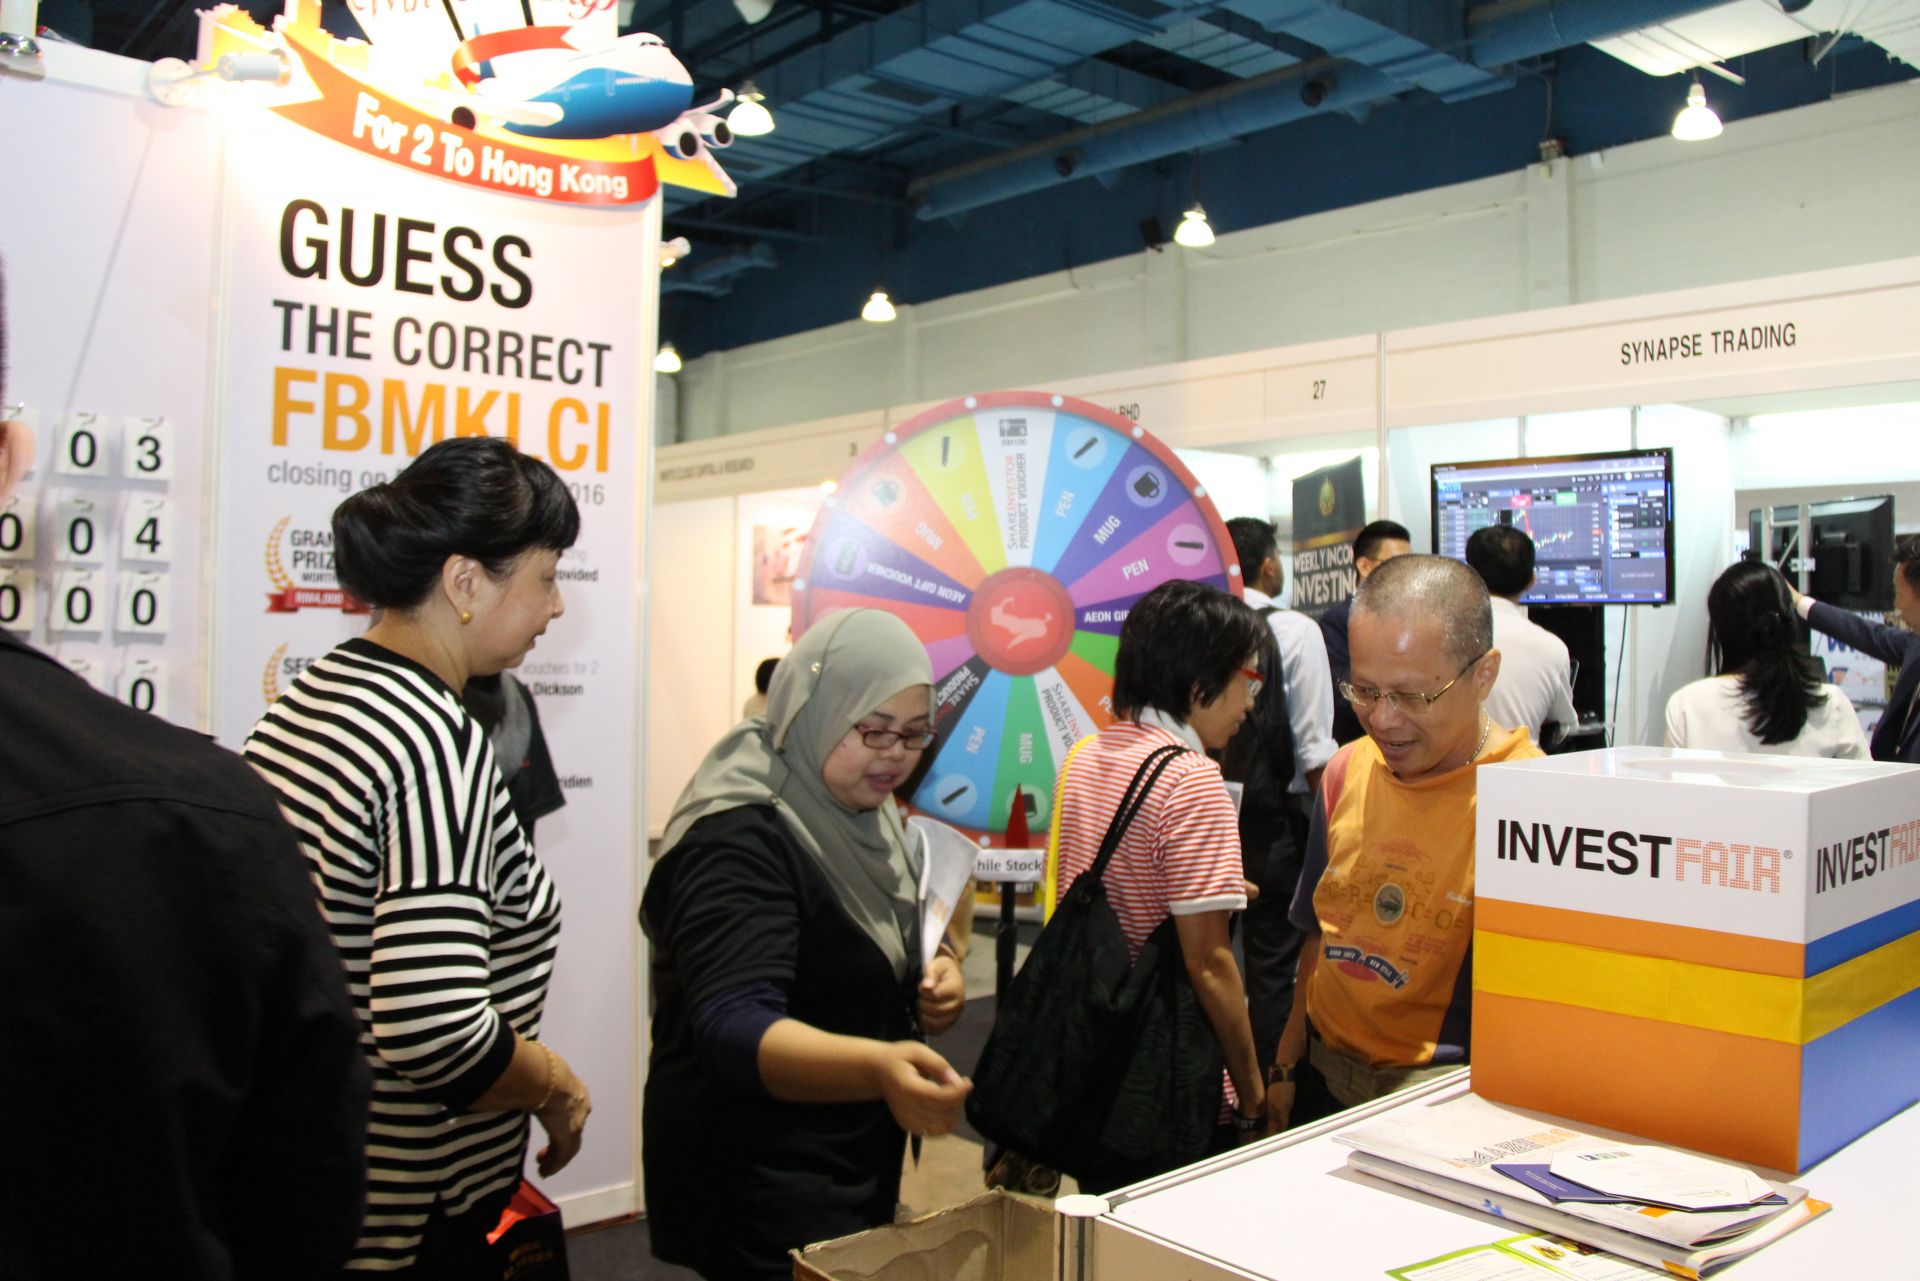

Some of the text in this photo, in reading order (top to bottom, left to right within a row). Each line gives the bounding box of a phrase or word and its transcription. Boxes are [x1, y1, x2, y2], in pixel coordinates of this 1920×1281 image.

[353, 91, 629, 199] For 2 To Hong Kong
[280, 198, 533, 309] GUESS
[272, 299, 612, 388] THE CORRECT
[1620, 322, 1797, 366] SYNAPSE TRADING
[1313, 380, 1327, 400] 27
[267, 459, 353, 494] closing
[568, 482, 606, 506] 016
[1056, 490, 1075, 518] PEN
[290, 530, 335, 548] GRAN
[1093, 514, 1121, 545] MUG
[292, 550, 337, 570] PRIZ
[1122, 558, 1150, 580] PEN
[1294, 543, 1354, 573] WEEKLY INCO
[557, 567, 598, 582] ovided
[867, 561, 966, 604] AEON GIFT VOUCHER
[1084, 611, 1130, 624] AEON GIF
[533, 682, 584, 696] Dickson
[1041, 689, 1068, 736] PRODUCT
[966, 725, 986, 754] PEN
[1019, 732, 1034, 764] MUG
[976, 858, 1002, 872] hile
